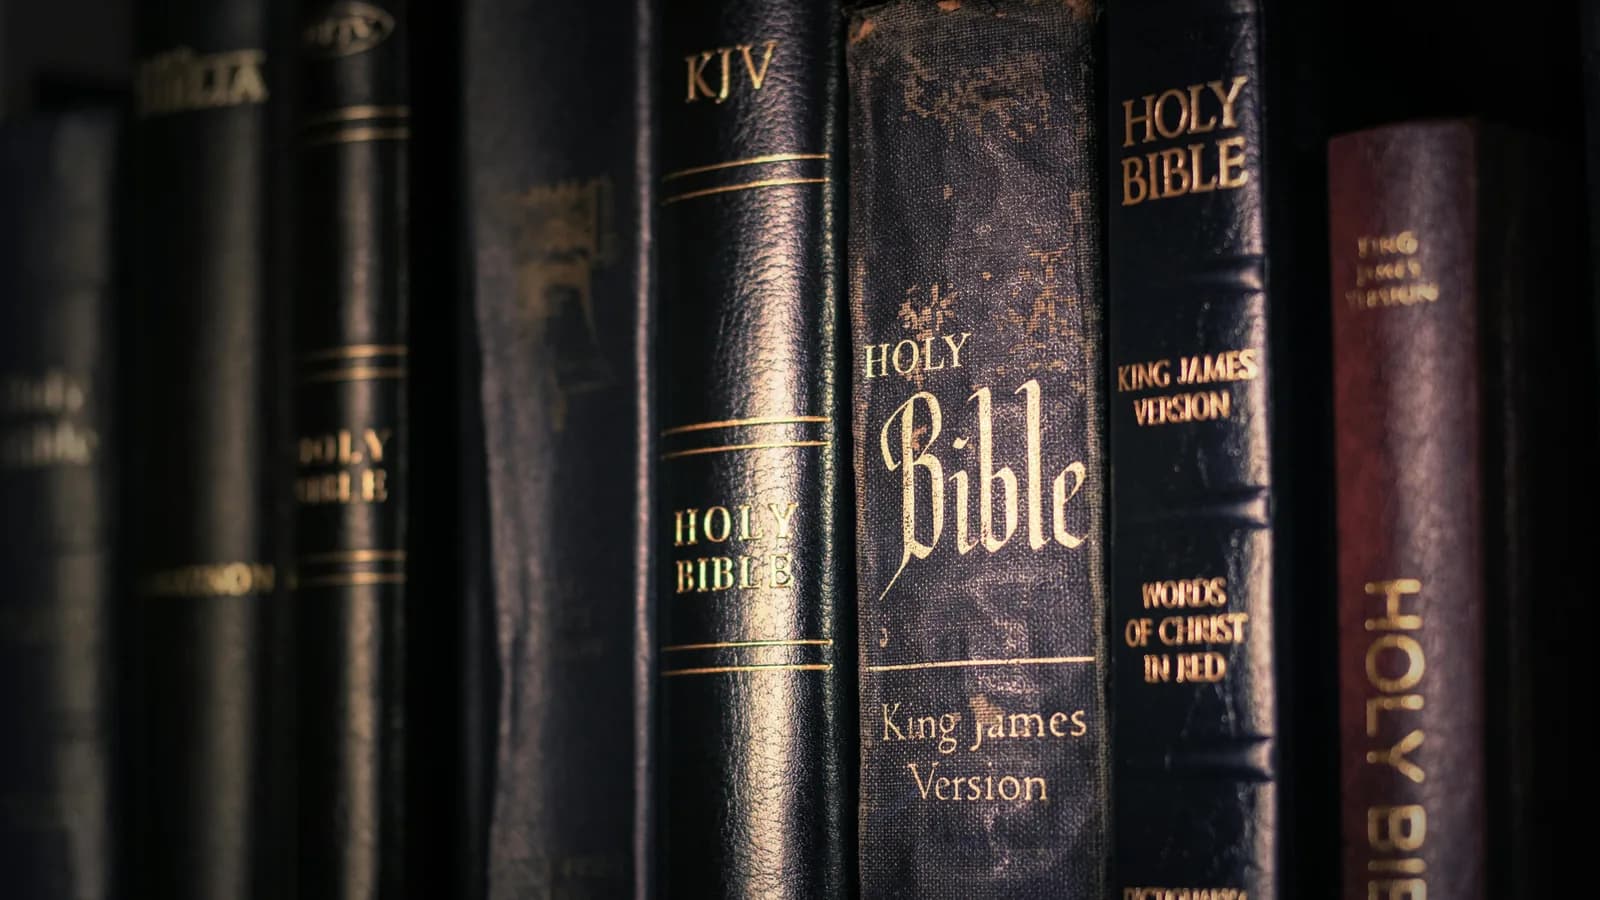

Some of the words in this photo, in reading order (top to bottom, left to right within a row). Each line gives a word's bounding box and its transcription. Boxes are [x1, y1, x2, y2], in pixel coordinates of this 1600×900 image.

[684, 40, 780, 104] KJV
[1121, 75, 1249, 148] HOLY
[1120, 136, 1249, 207] BIBLE
[864, 333, 971, 379] HOLY
[1117, 359, 1171, 392] KING
[1176, 349, 1257, 385] JAMES
[1133, 389, 1232, 427] VERSION
[880, 379, 1089, 601] Bible
[673, 502, 799, 548] HOLY
[675, 554, 795, 594] BIBLE
[1142, 576, 1228, 610] WORDS
[1124, 617, 1153, 648] OF
[1158, 611, 1249, 647] CHRIST
[1143, 653, 1171, 684] IN
[1175, 651, 1228, 685] RED
[1364, 578, 1426, 783] HOLY
[881, 702, 962, 754] King
[909, 761, 1049, 802] Version
